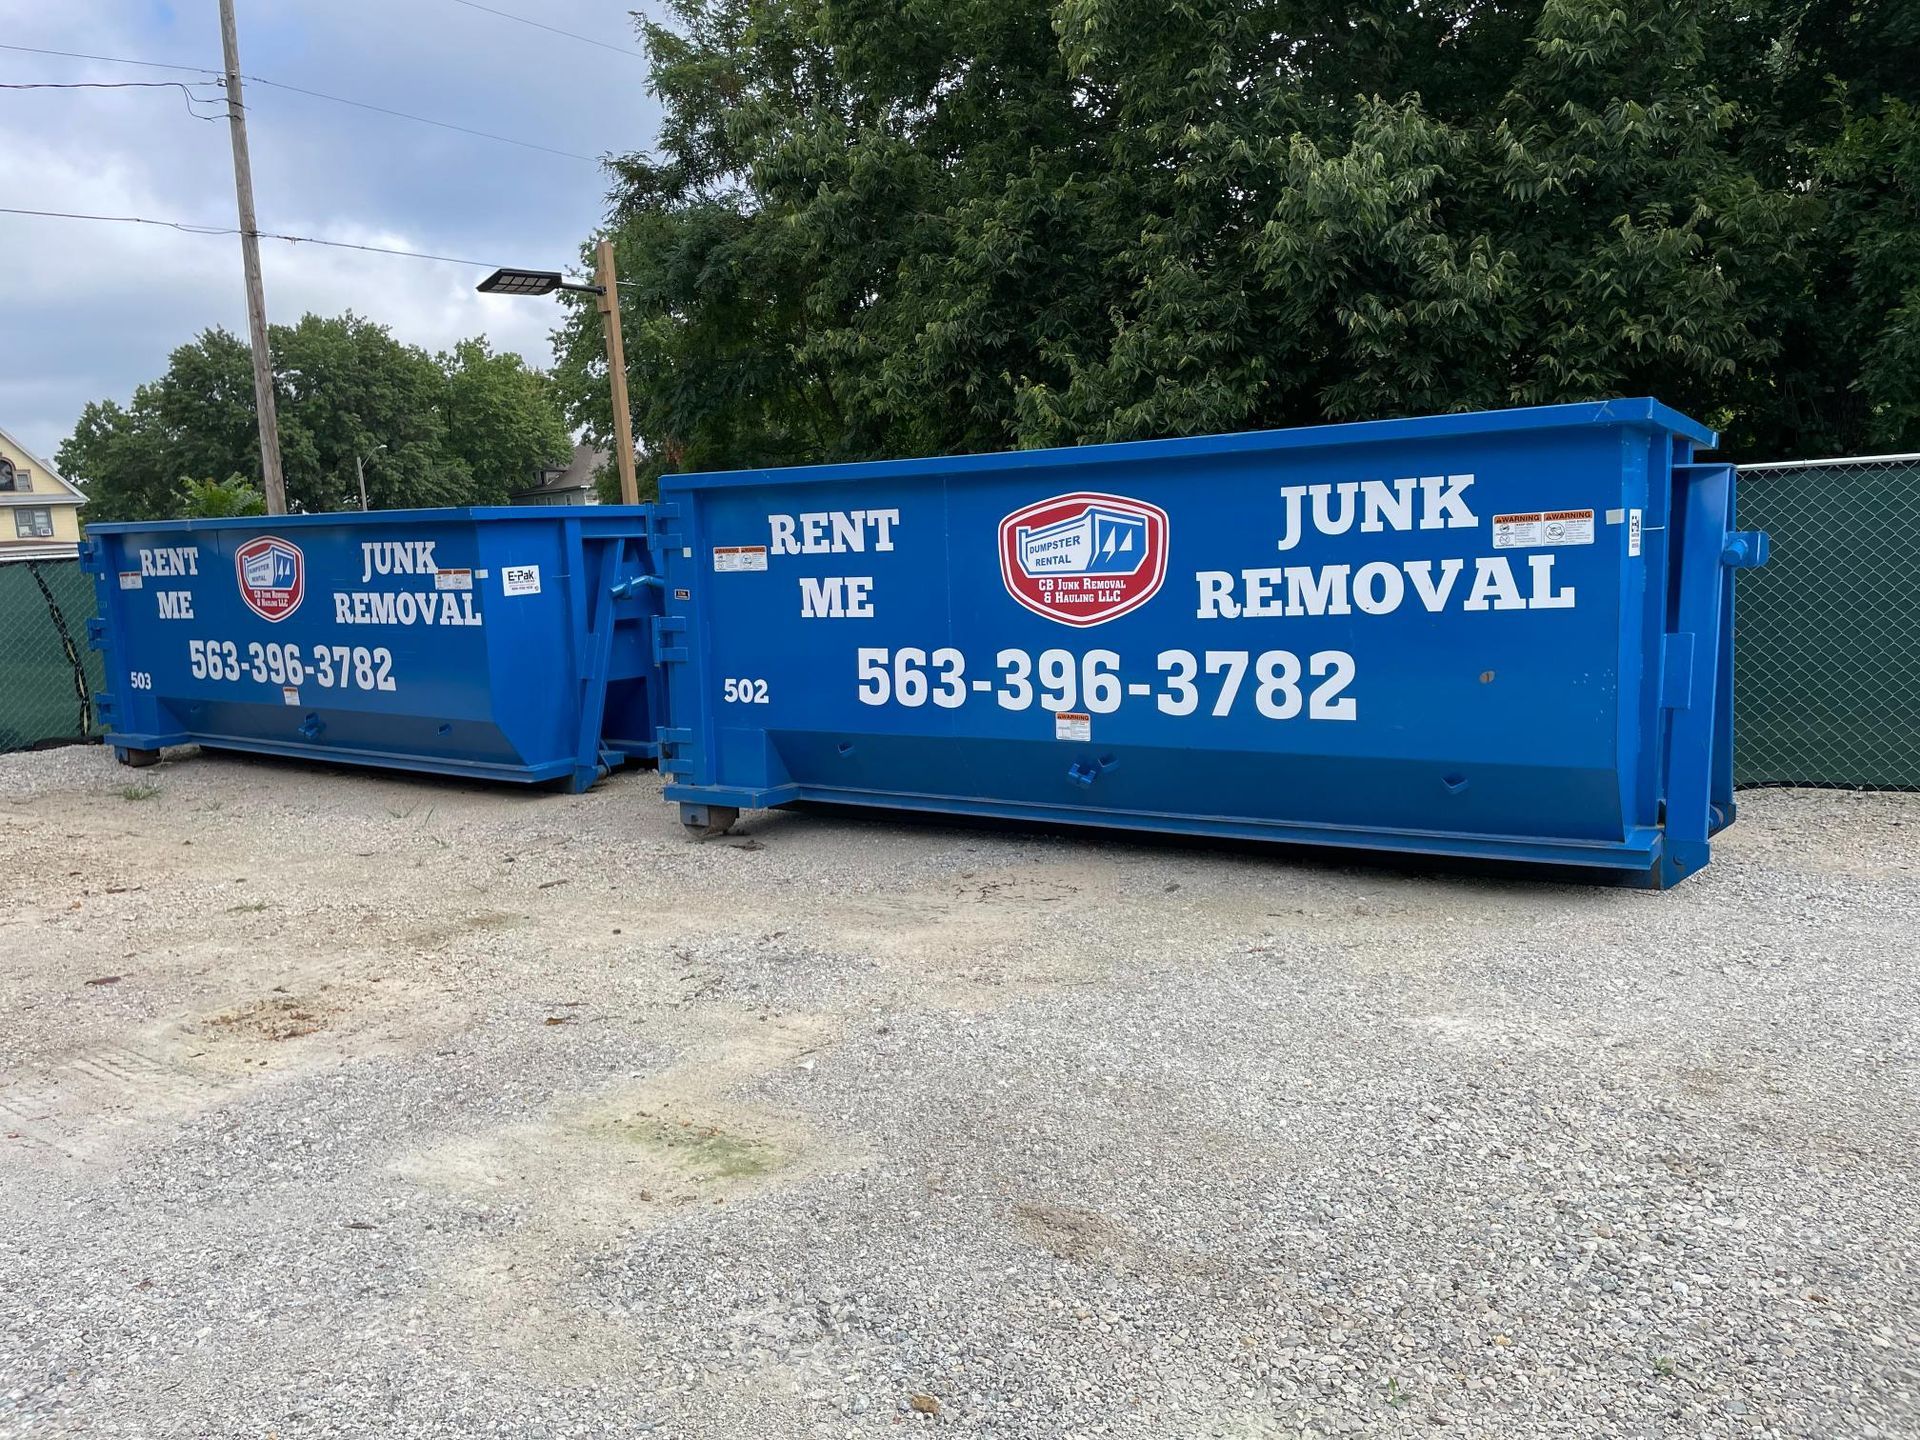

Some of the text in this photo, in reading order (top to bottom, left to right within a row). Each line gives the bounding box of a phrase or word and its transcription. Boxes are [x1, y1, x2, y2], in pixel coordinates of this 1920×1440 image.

[1278, 473, 1479, 551] JUNK
[1502, 514, 1540, 523] WARNING
[1551, 511, 1591, 520] WARNING
[768, 508, 900, 555] RENT
[1029, 535, 1081, 554] DUMPSTER
[139, 547, 199, 577] RENT
[361, 541, 439, 583] JUNK
[1035, 554, 1072, 567] RENTAL
[507, 569, 535, 581] E-Pak
[1038, 578, 1127, 591] CB JUNK REMOVAL
[1195, 554, 1576, 619] REMOVAL
[156, 591, 194, 619] ME
[333, 591, 483, 626] REMOVAL
[799, 576, 874, 618] ME
[1043, 590, 1121, 604] & HAULING LLC
[189, 640, 397, 691] 563-396-3782
[130, 671, 152, 690] 503
[724, 678, 770, 704] 502
[857, 647, 1357, 721] 563-396-3782
